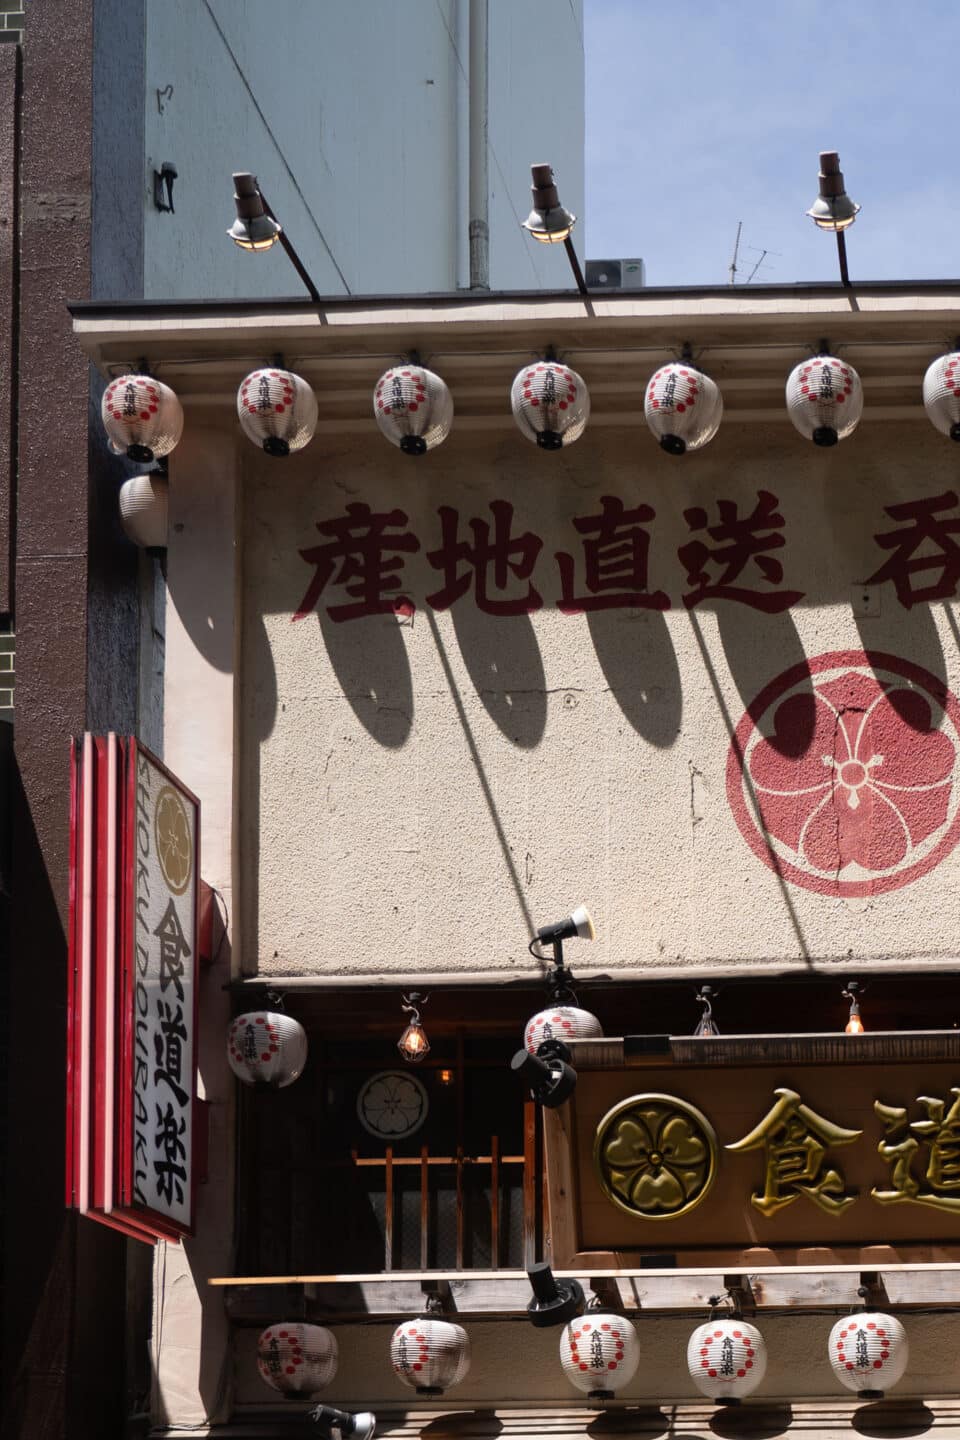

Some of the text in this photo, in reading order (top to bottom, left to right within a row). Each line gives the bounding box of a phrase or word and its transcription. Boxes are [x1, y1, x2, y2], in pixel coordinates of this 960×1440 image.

[292, 490, 806, 624] 産地直送
[153, 898, 192, 1207] 食道楽
[270, 1337, 281, 1374] 食道楽
[398, 1334, 409, 1370] 食道楽
[590, 1328, 605, 1369] 食道楽
[721, 1335, 735, 1376] 食道楽
[855, 1328, 870, 1368] 食道楽
